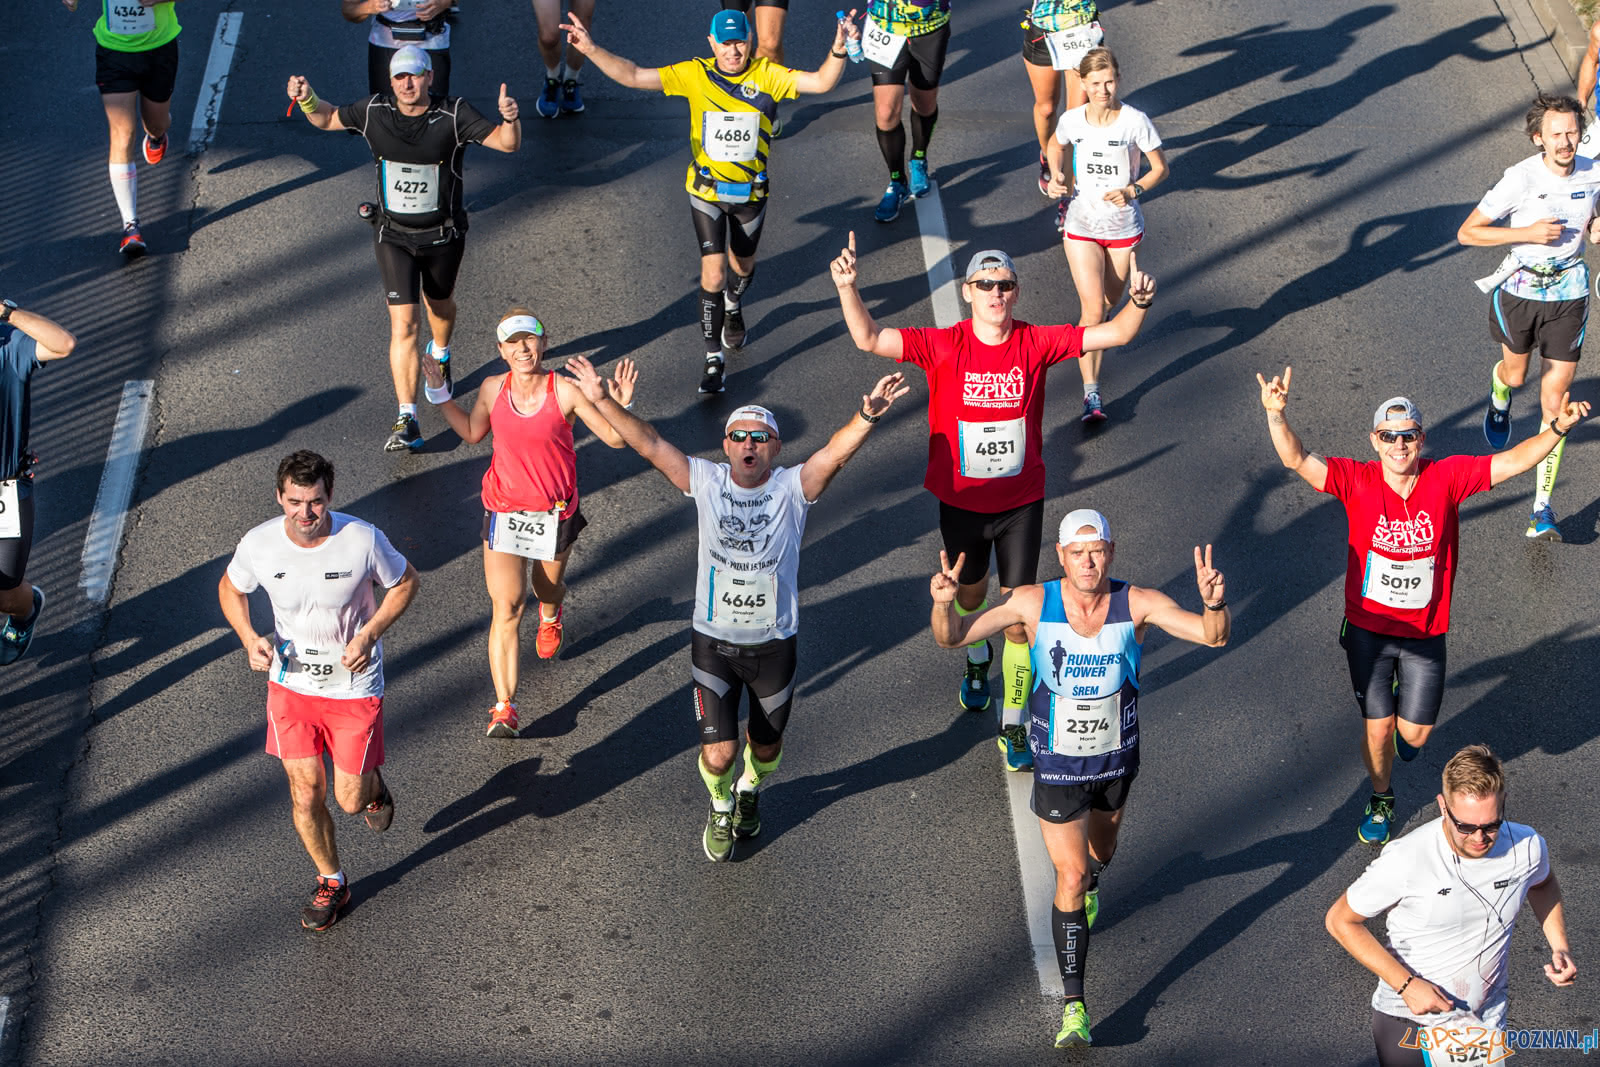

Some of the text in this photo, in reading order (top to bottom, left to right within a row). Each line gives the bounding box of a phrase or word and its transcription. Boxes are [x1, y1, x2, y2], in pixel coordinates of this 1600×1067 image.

[114, 6, 146, 17] 4342
[868, 29, 891, 46] 430
[1063, 38, 1093, 50] 5843
[714, 129, 751, 142] 4686
[1087, 163, 1119, 176] 5381
[394, 180, 428, 194] 4272
[964, 371, 1014, 383] DRUŻYNA
[963, 381, 1024, 399] SZPIKU
[963, 400, 1020, 409] www.darszpiku.pl
[975, 440, 1015, 456] 4831
[508, 517, 545, 536] 5743
[1372, 525, 1434, 546] SZPIKU
[1380, 573, 1422, 589] 5019
[722, 592, 766, 608] 4645
[1067, 654, 1122, 666] RUNNERS
[1064, 666, 1107, 678] POWER
[1072, 685, 1099, 696] ŚREM
[1066, 718, 1109, 734] 2374
[1040, 766, 1125, 782] www.runnerspower.pl
[1437, 888, 1452, 896] 4F
